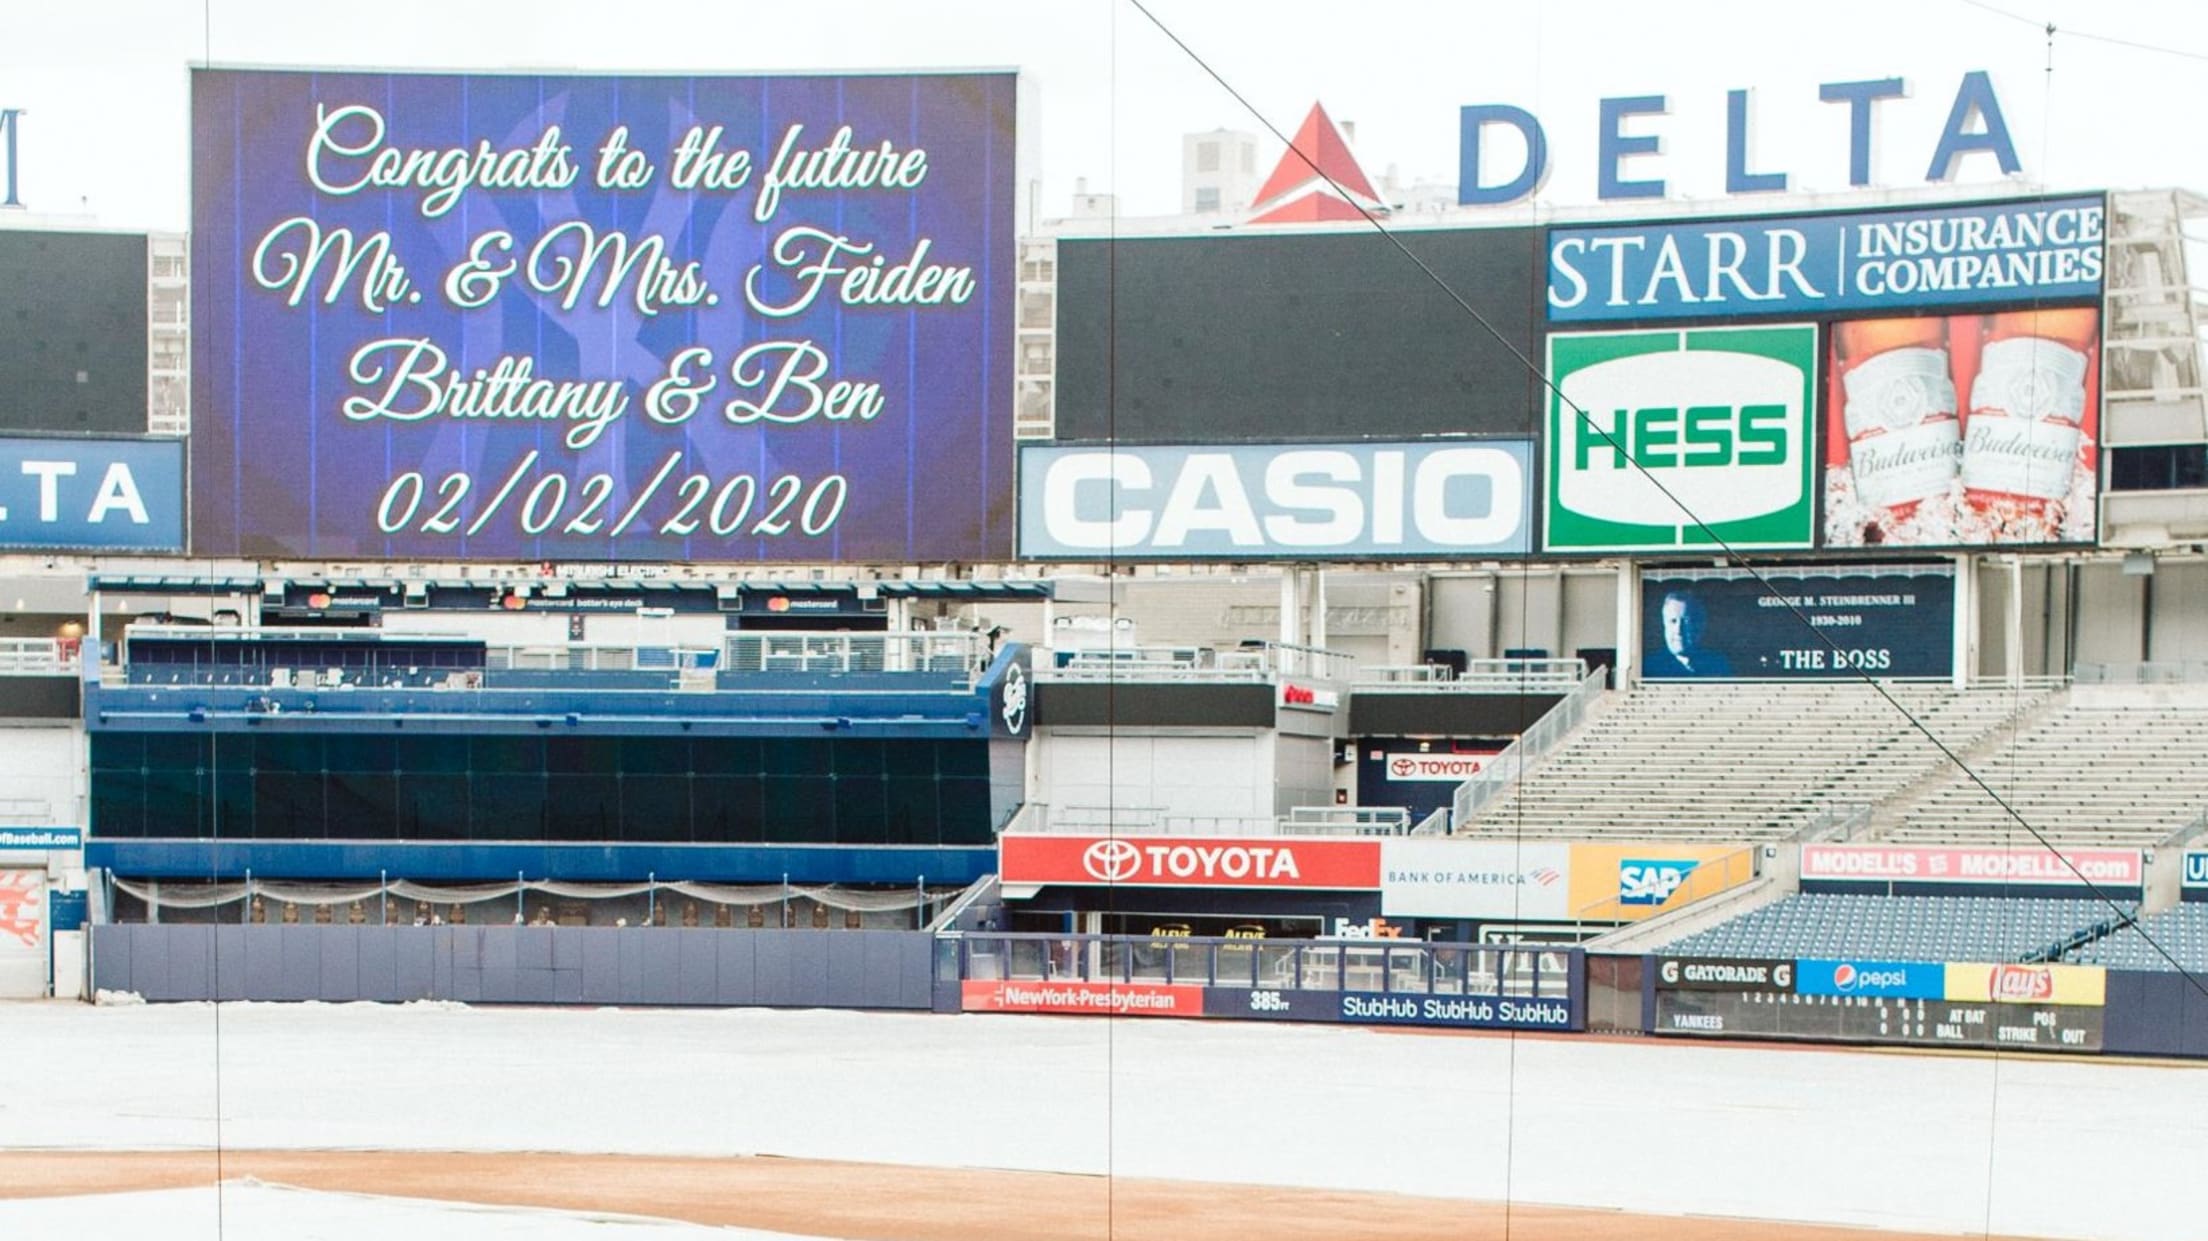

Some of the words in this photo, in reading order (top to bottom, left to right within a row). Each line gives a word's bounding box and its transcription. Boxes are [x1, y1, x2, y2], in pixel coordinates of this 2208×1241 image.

[1459, 70, 2023, 206] DELTA
[306, 102, 581, 218] Congrats
[596, 126, 655, 189] to
[670, 125, 753, 190] the
[754, 124, 929, 222] future
[1857, 206, 2103, 257] INSURANCE
[251, 217, 422, 313] Mr.
[444, 230, 518, 308] &
[526, 221, 719, 316] Mrs.
[745, 226, 977, 317] Feiden
[1547, 230, 1827, 309] STARR
[1856, 246, 2102, 296] COMPANIES
[342, 337, 631, 449] Brittany
[644, 347, 718, 424] &
[724, 340, 886, 424] Ben
[1575, 404, 1788, 470] HESS
[0, 460, 150, 525] TA
[376, 450, 849, 538] 02/02/2020
[1044, 447, 1523, 548] CASIO
[1758, 596, 1802, 607] GEORGE
[1804, 596, 1817, 607] M.
[1820, 595, 1900, 607] STEINBRENNER
[1780, 650, 1825, 670] THE
[1833, 649, 1892, 670] BOSS
[1419, 761, 1481, 775] TOYOTA
[1146, 845, 1299, 880] TOYOTA
[2188, 856, 2208, 880] U
[1388, 871, 1429, 883] BANK
[1434, 872, 1453, 884] OF
[1457, 872, 1527, 886] AMERICA
[1620, 867, 1681, 899] SAP
[1335, 917, 1402, 939] FedEx
[1662, 961, 1679, 983] G
[1684, 965, 1767, 984] GATORADE
[1773, 964, 1791, 987] G
[1859, 970, 1906, 990] pepsi
[1250, 991, 1279, 1010] 385
[1343, 996, 1418, 1018] StubHub
[1424, 1001, 1493, 1021] StubHub
[1499, 1002, 1568, 1024] StubHub
[1673, 1014, 1723, 1029] YANKEES
[1949, 1009, 1963, 1023] AT
[1936, 1024, 1963, 1039] BALL
[1998, 1026, 2037, 1041] STRIKE
[2062, 1030, 2086, 1043] OUT
